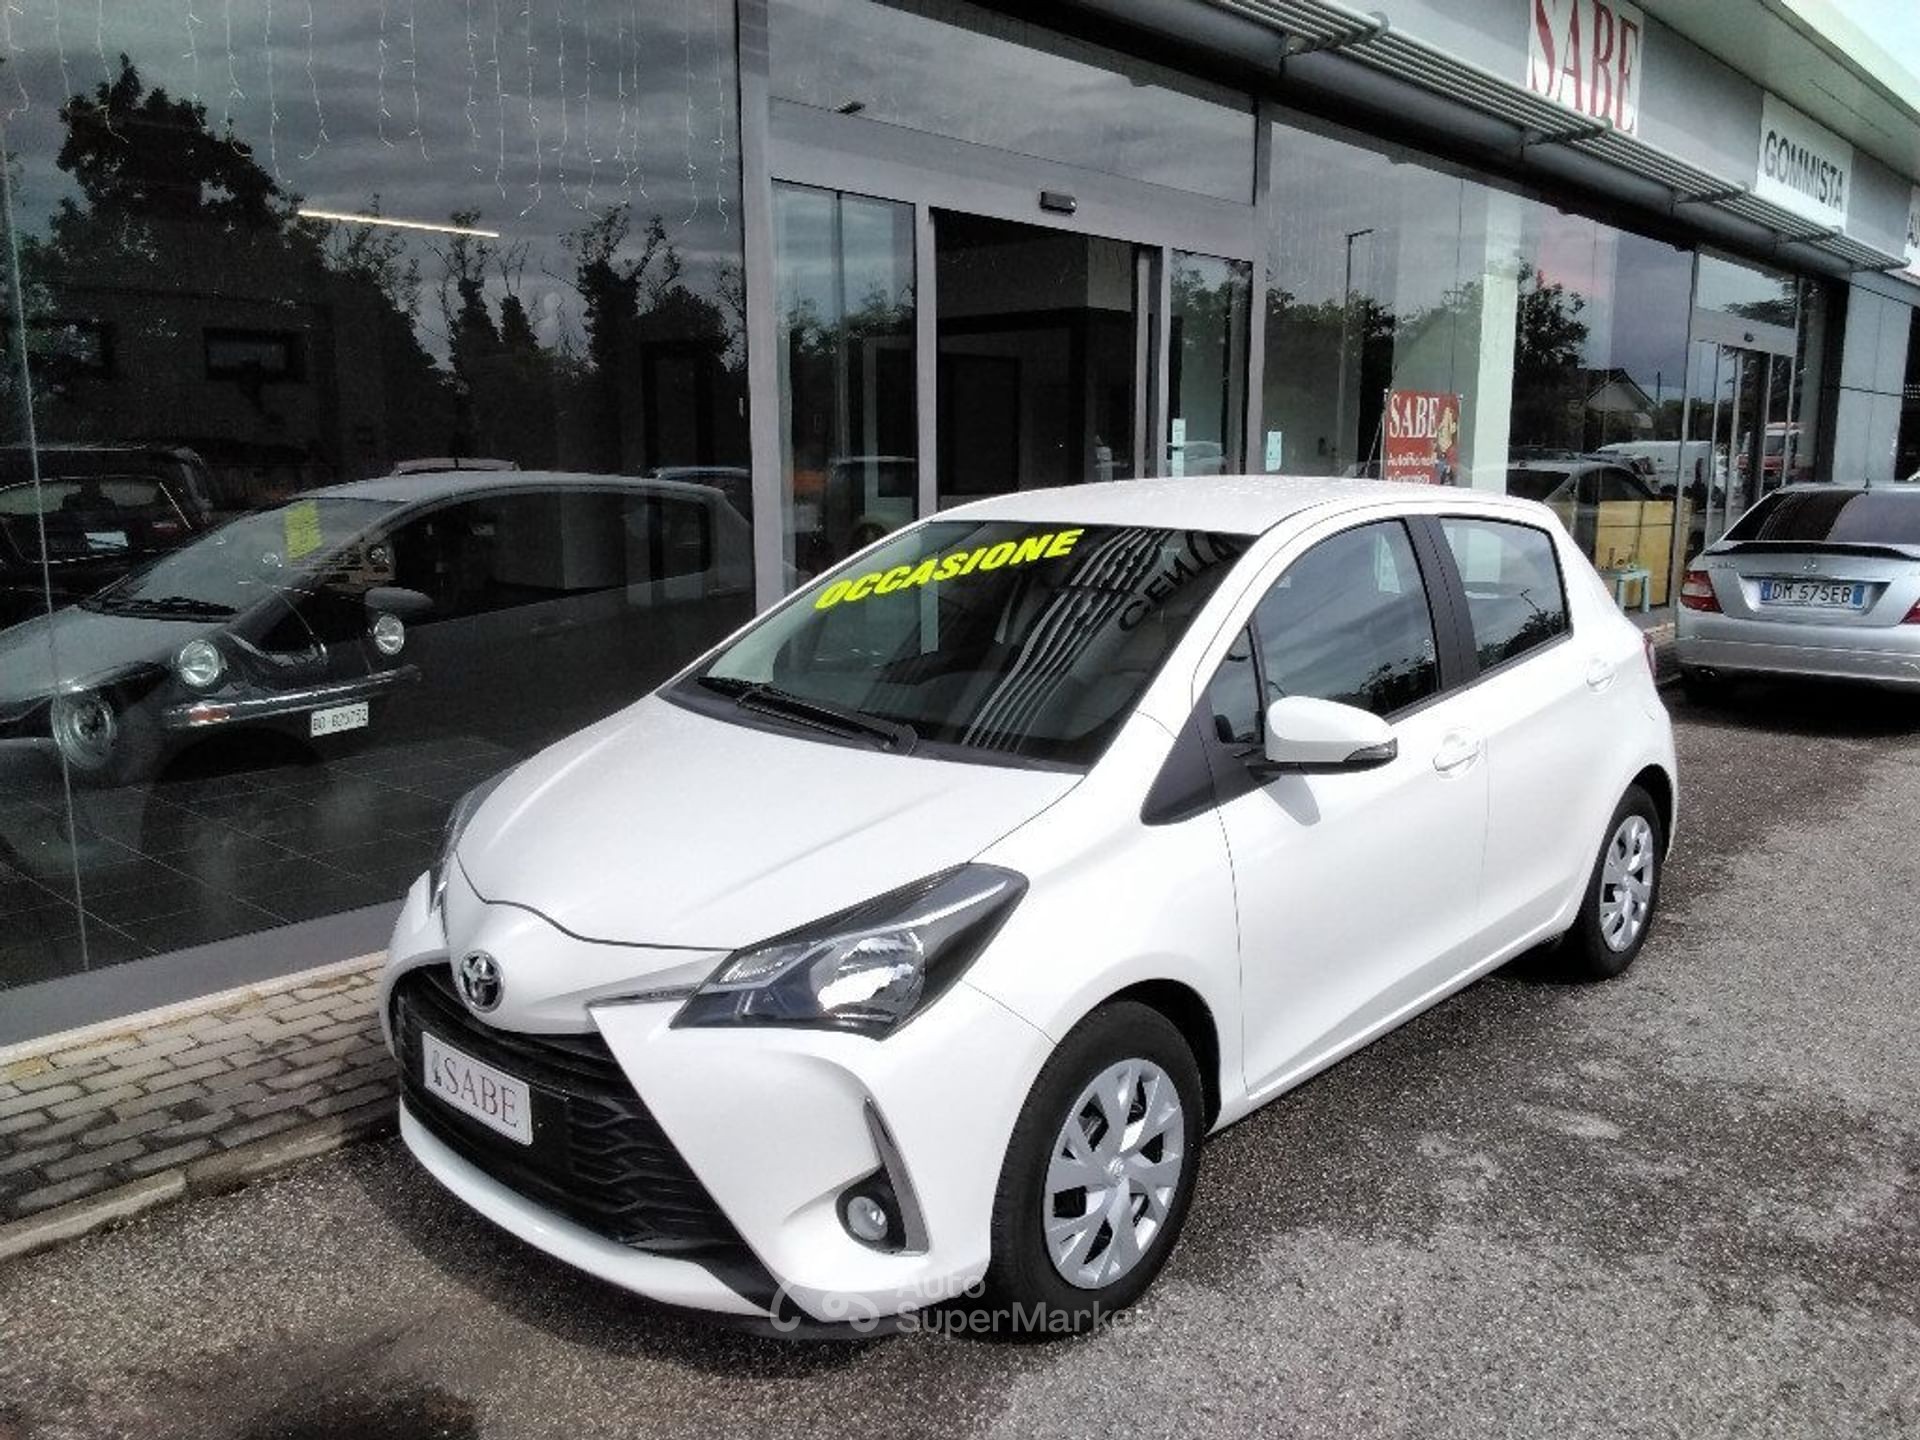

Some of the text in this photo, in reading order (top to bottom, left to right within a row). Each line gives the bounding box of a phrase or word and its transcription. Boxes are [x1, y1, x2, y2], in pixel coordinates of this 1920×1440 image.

[1531, 0, 1639, 134] SABE
[1764, 130, 1844, 213] GOMMISTA
[1389, 394, 1440, 439] SABE
[815, 529, 1085, 610] OCCASIONE
[444, 1057, 518, 1129] SABE
